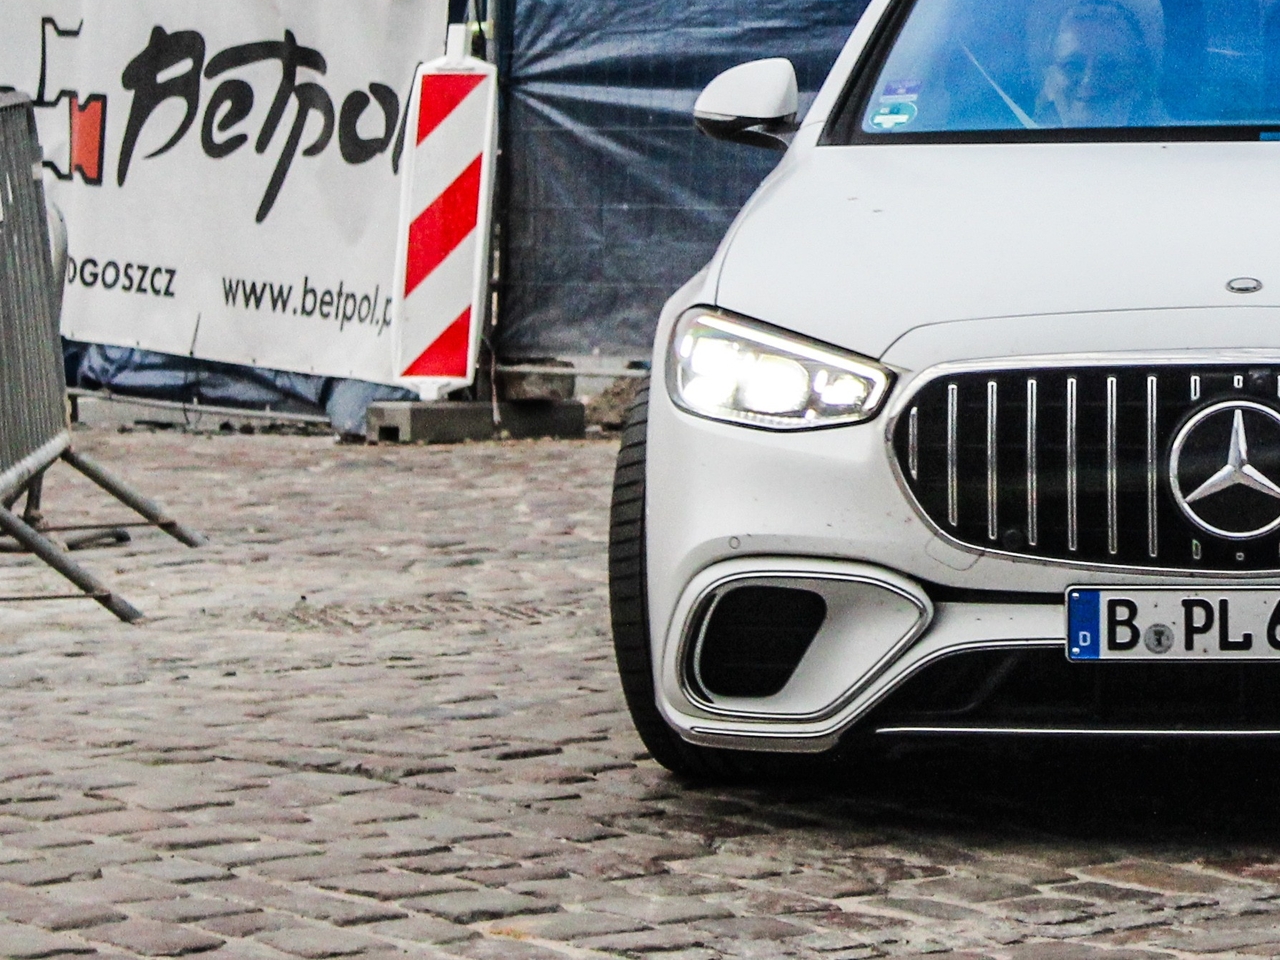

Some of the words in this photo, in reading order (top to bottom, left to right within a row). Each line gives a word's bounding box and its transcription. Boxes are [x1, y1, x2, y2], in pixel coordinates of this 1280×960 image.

[222, 275, 392, 336] www.betpol.p
[1078, 631, 1091, 647] D
[1107, 598, 1140, 651] B
[1181, 598, 1253, 651] PL
